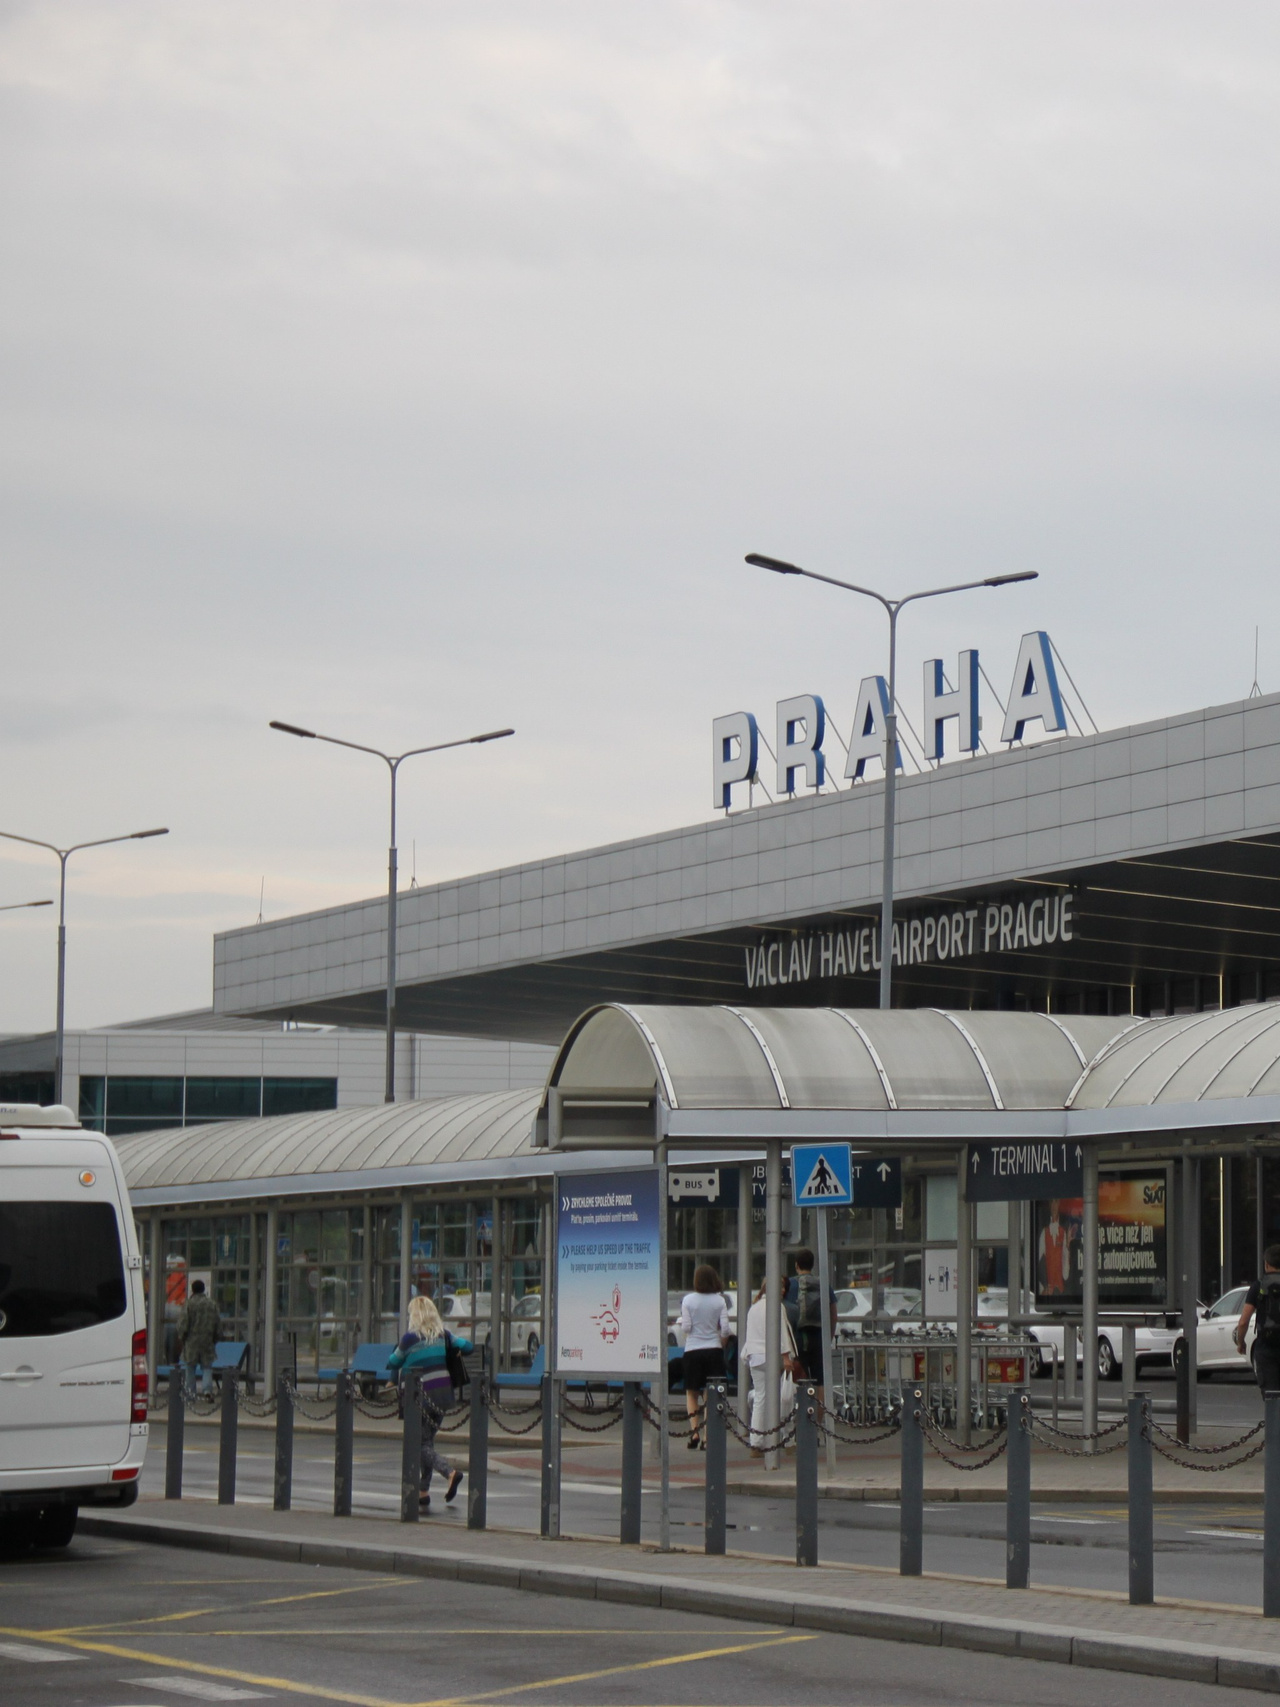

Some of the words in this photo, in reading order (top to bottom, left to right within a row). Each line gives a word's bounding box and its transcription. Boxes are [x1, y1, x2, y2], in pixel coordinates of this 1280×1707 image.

[713, 631, 1067, 809] PRAHA
[745, 936, 814, 989] VÁCLAV
[820, 929, 882, 977] HAVEL
[891, 910, 978, 965] AIRPORT
[984, 894, 1073, 953] PRAGUE
[991, 1144, 1057, 1175] TERMINAL
[1061, 1144, 1066, 1172] 1
[685, 1180, 702, 1189] BUS
[571, 1196, 594, 1208] ZRYCHLEME
[595, 1193, 615, 1207] SPOLEČNÉ
[616, 1194, 632, 1206] PROVOZ
[1098, 1224, 1105, 1247] je
[1107, 1222, 1123, 1244] více
[1125, 1221, 1139, 1244] než
[1141, 1222, 1154, 1246] jen
[570, 1245, 586, 1256] PLEASE
[587, 1244, 597, 1255] HELP
[598, 1244, 603, 1255] US
[604, 1244, 617, 1255] SPEED
[618, 1244, 624, 1254] UP
[634, 1243, 651, 1254] TRAFFIC
[1104, 1247, 1157, 1272] autopůjčovna.
[595, 1262, 607, 1272] parking
